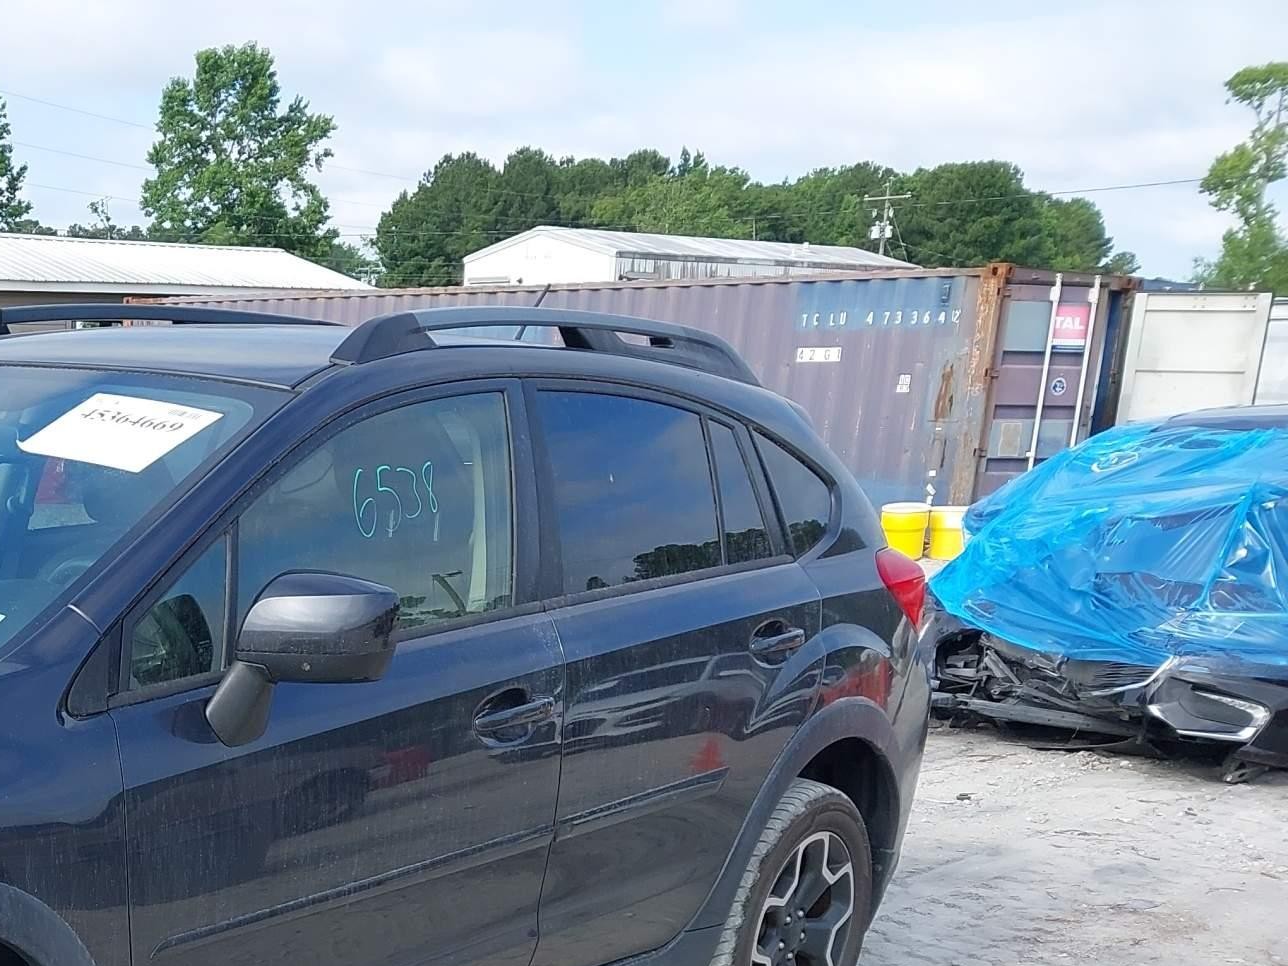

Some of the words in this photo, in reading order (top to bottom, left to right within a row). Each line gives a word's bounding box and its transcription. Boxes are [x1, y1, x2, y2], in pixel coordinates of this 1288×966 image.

[1055, 316, 1085, 330] TAL
[79, 408, 185, 432] 45364669
[353, 460, 439, 538] 6538
